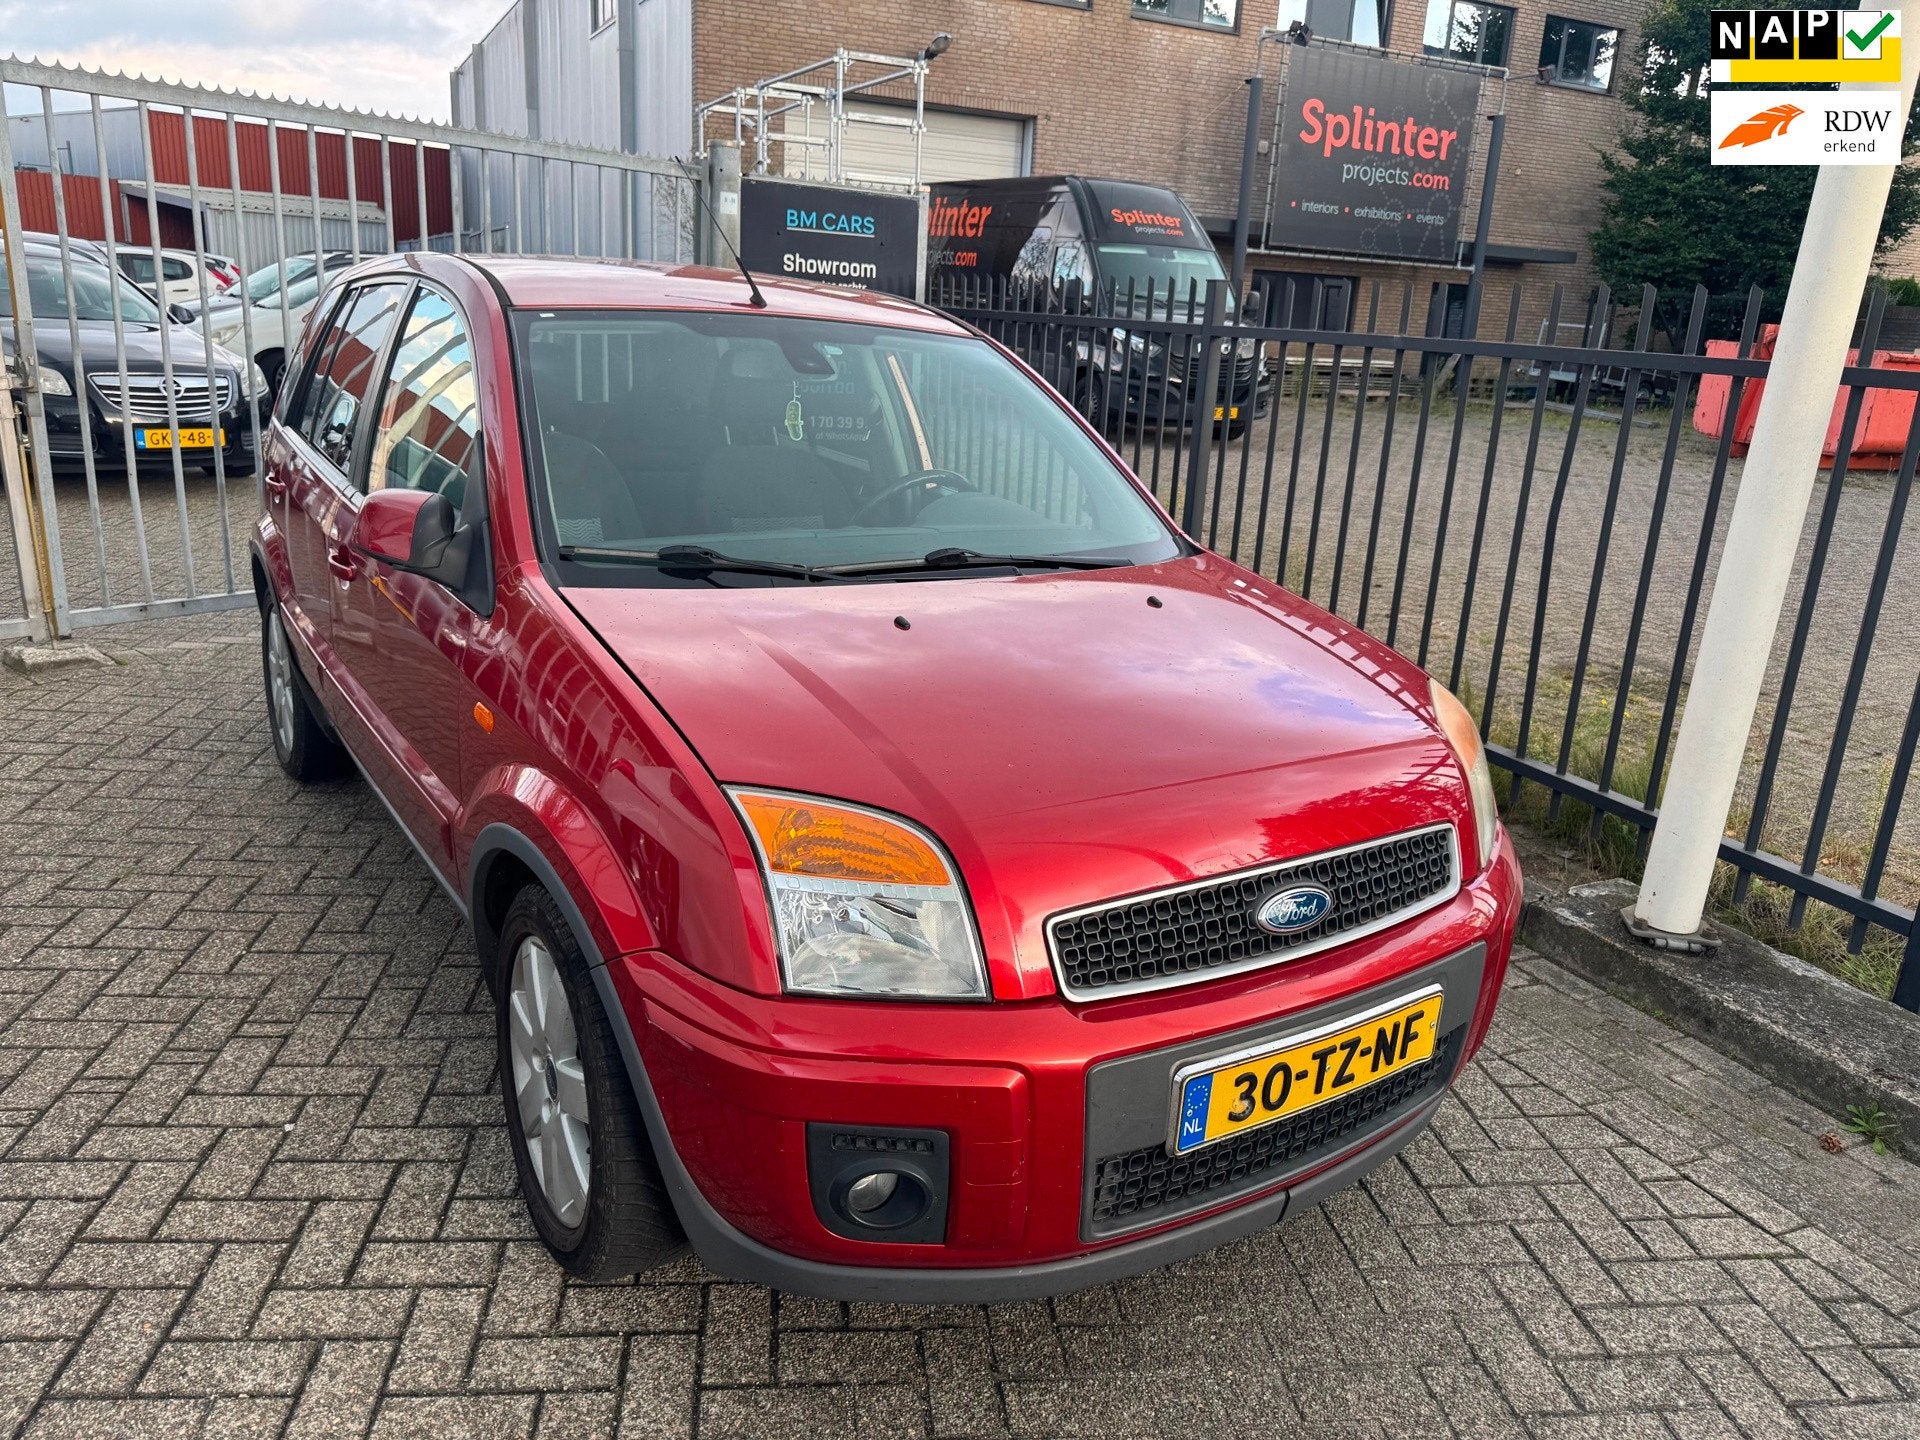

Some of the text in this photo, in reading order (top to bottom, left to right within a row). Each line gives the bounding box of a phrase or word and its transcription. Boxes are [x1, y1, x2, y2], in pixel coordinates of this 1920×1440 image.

[1300, 98, 1457, 160] Splinter
[1342, 163, 1450, 191] projects.com
[786, 209, 875, 235] BM CARS
[928, 196, 993, 238] linter
[1111, 208, 1182, 228] Splinter
[1301, 200, 1445, 225] interiors exhibitions events
[1134, 226, 1185, 237] projects.com
[783, 253, 877, 279] Showroom
[927, 247, 978, 268] ojects.com
[837, 416, 853, 429] 39
[150, 432, 215, 446] GK-48-
[1278, 896, 1318, 923] Ford
[1228, 1009, 1425, 1122] 30-TZ-NF
[1183, 1118, 1203, 1137] NL
